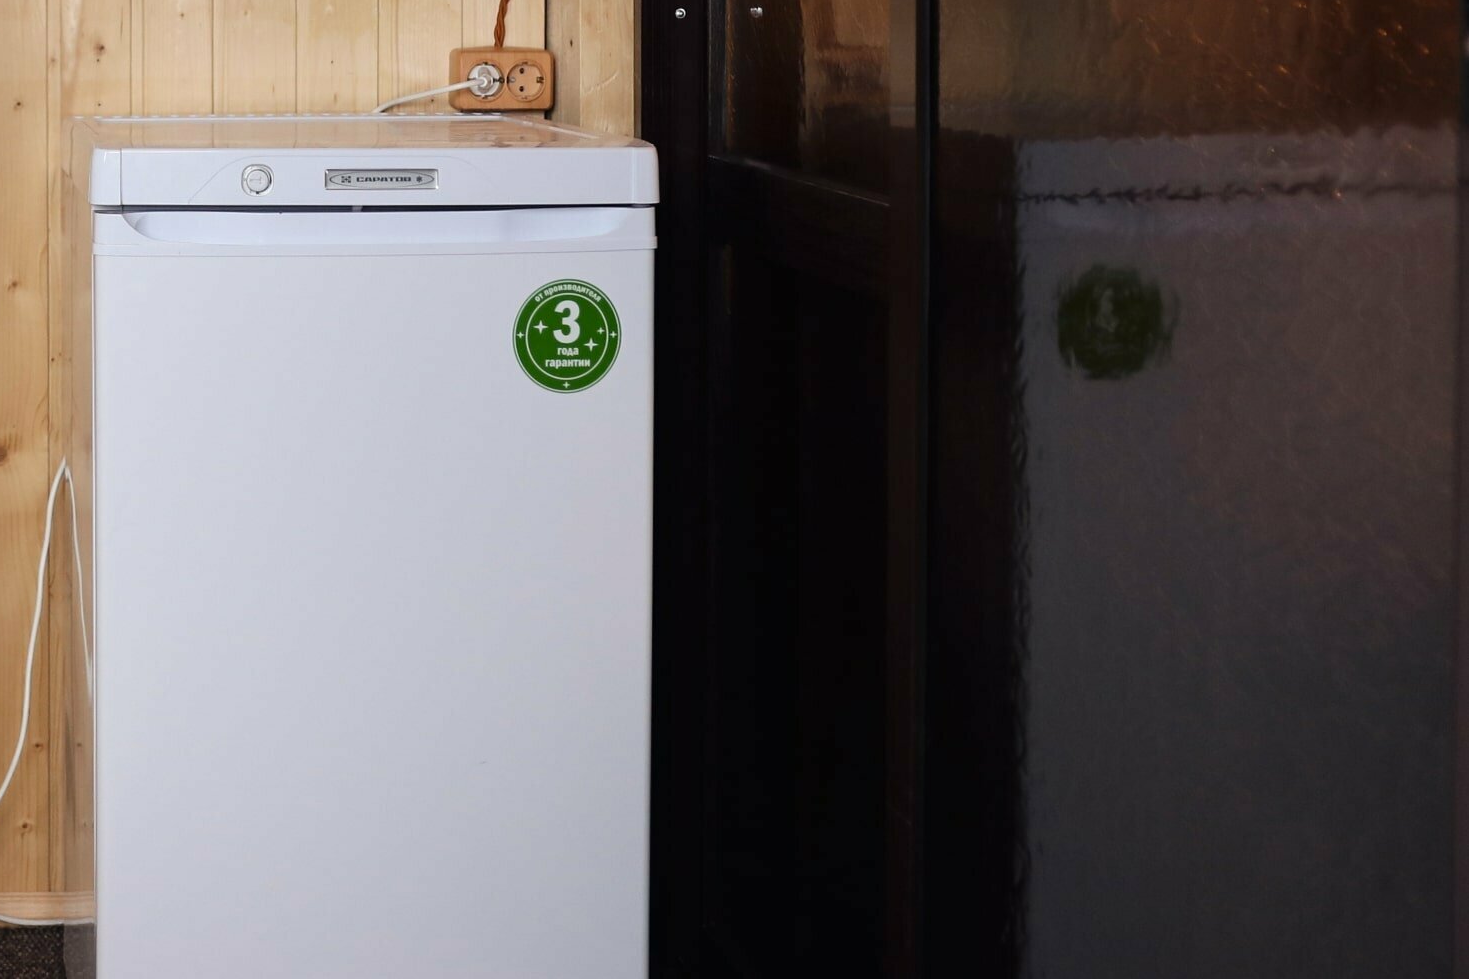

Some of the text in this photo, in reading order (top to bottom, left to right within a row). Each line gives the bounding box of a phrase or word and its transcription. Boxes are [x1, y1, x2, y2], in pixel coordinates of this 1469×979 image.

[534, 283, 602, 303] от производителя
[552, 300, 581, 344] 3
[557, 347, 579, 356] года
[545, 358, 591, 369] гарантии
